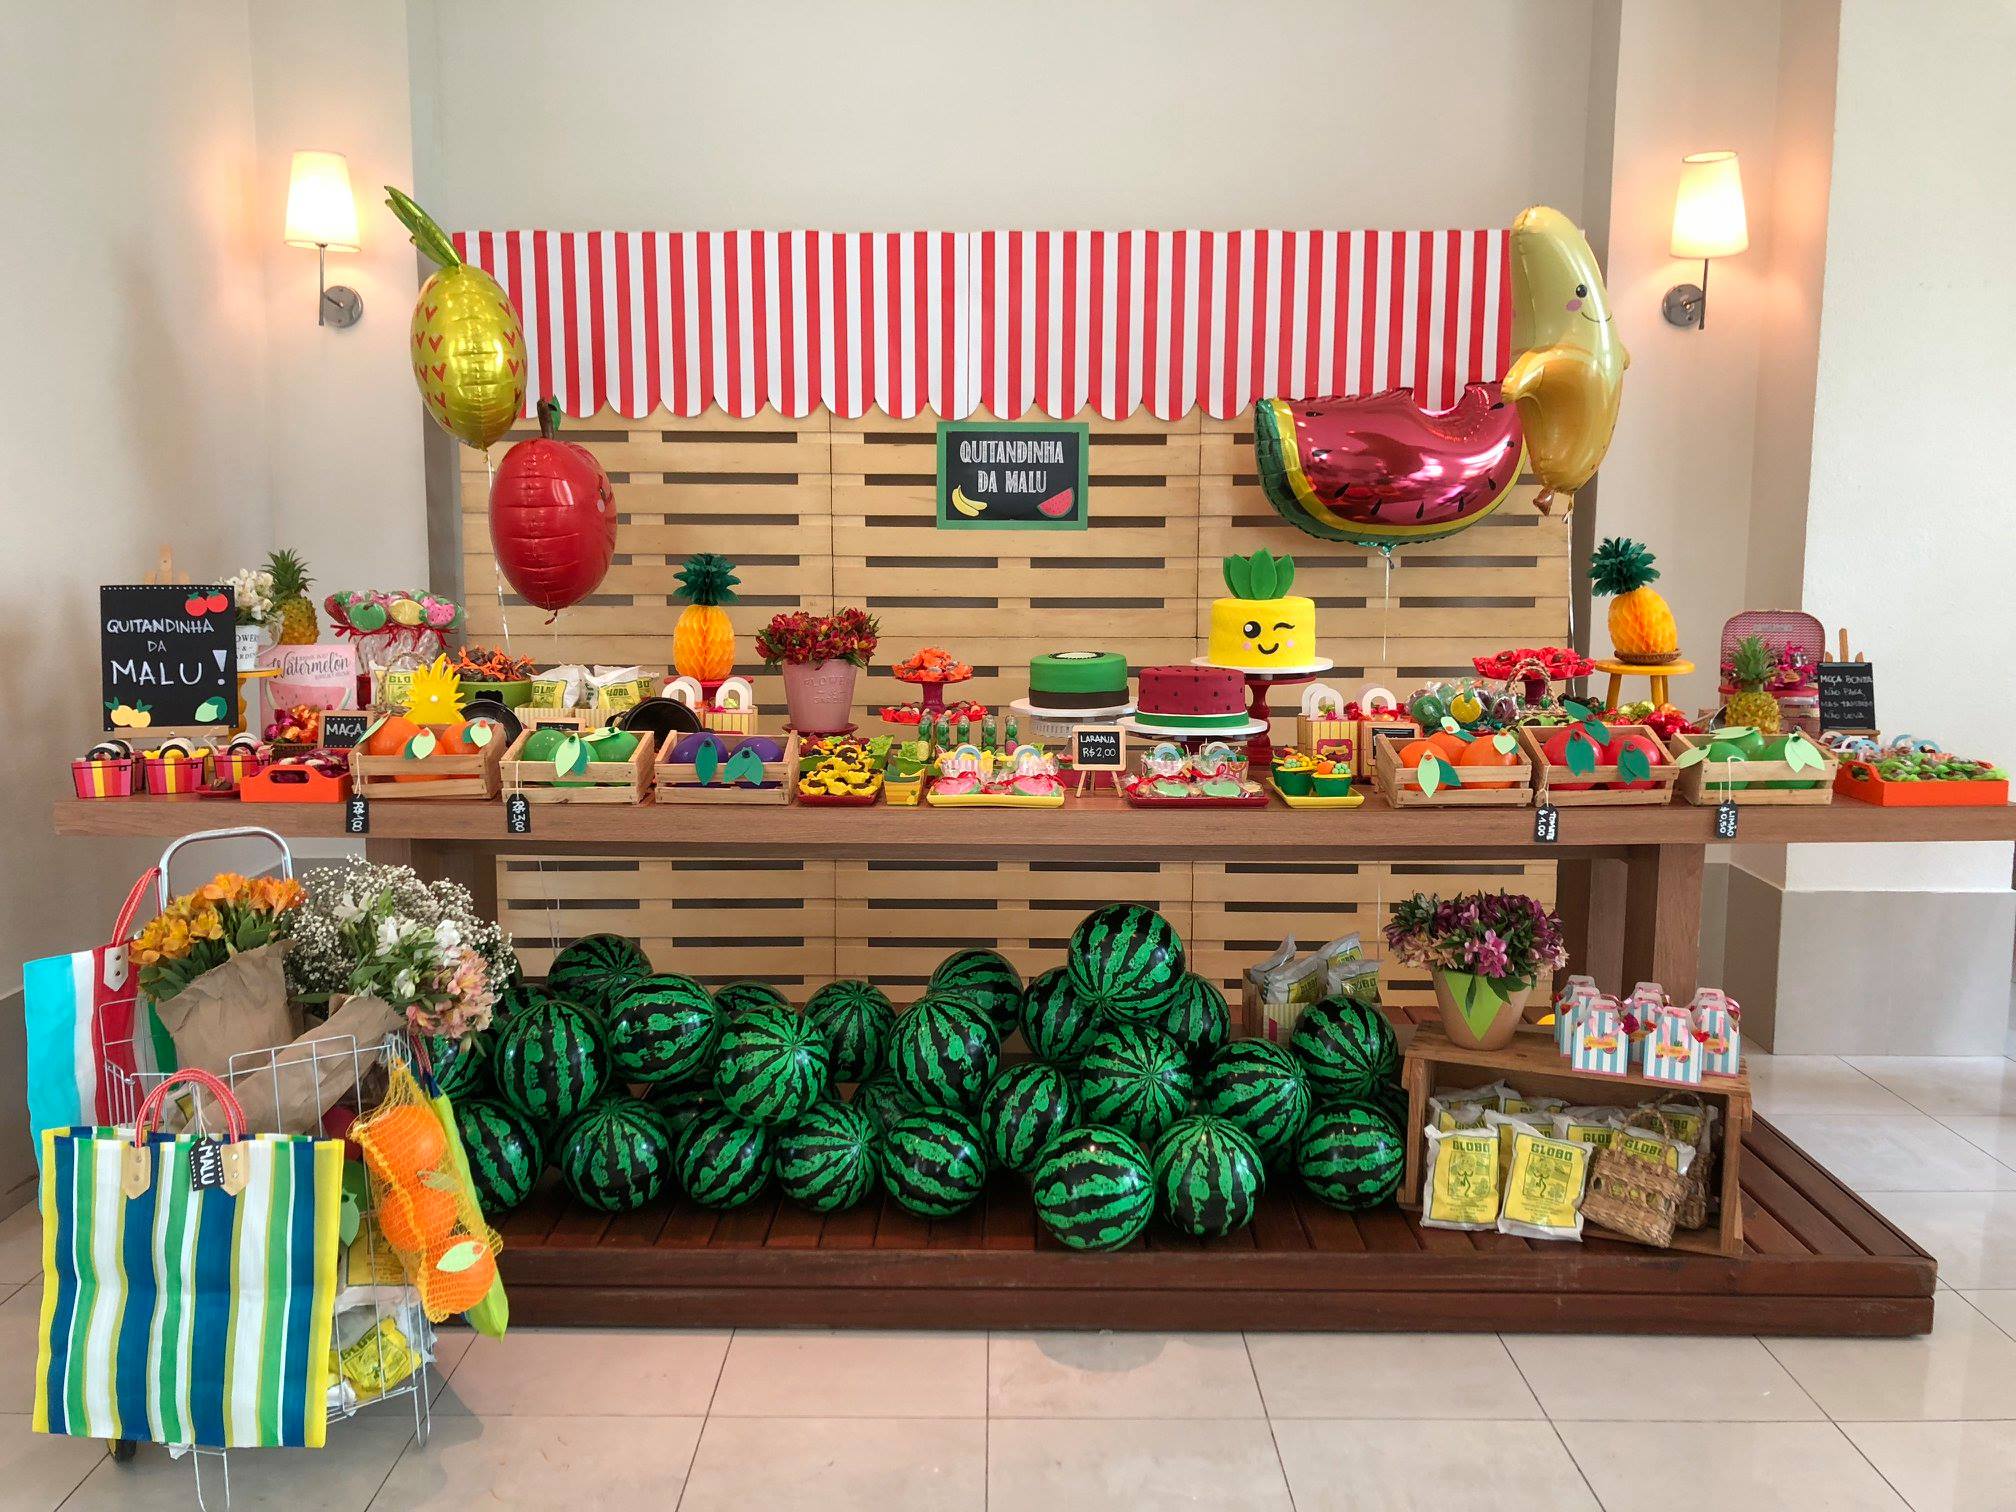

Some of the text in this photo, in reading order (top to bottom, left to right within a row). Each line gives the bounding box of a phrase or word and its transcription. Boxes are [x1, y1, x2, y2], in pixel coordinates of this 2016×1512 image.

[960, 440, 1064, 464] QUITANDINHA
[978, 470, 1047, 493] DA MALU
[106, 618, 215, 634] QUITANDINHA
[147, 640, 167, 652] DA
[1080, 734, 1116, 744] LARANJA
[1452, 1140, 1491, 1153] GLOBO
[1531, 1143, 1573, 1163] GLOBO
[199, 1145, 215, 1185] MALU
